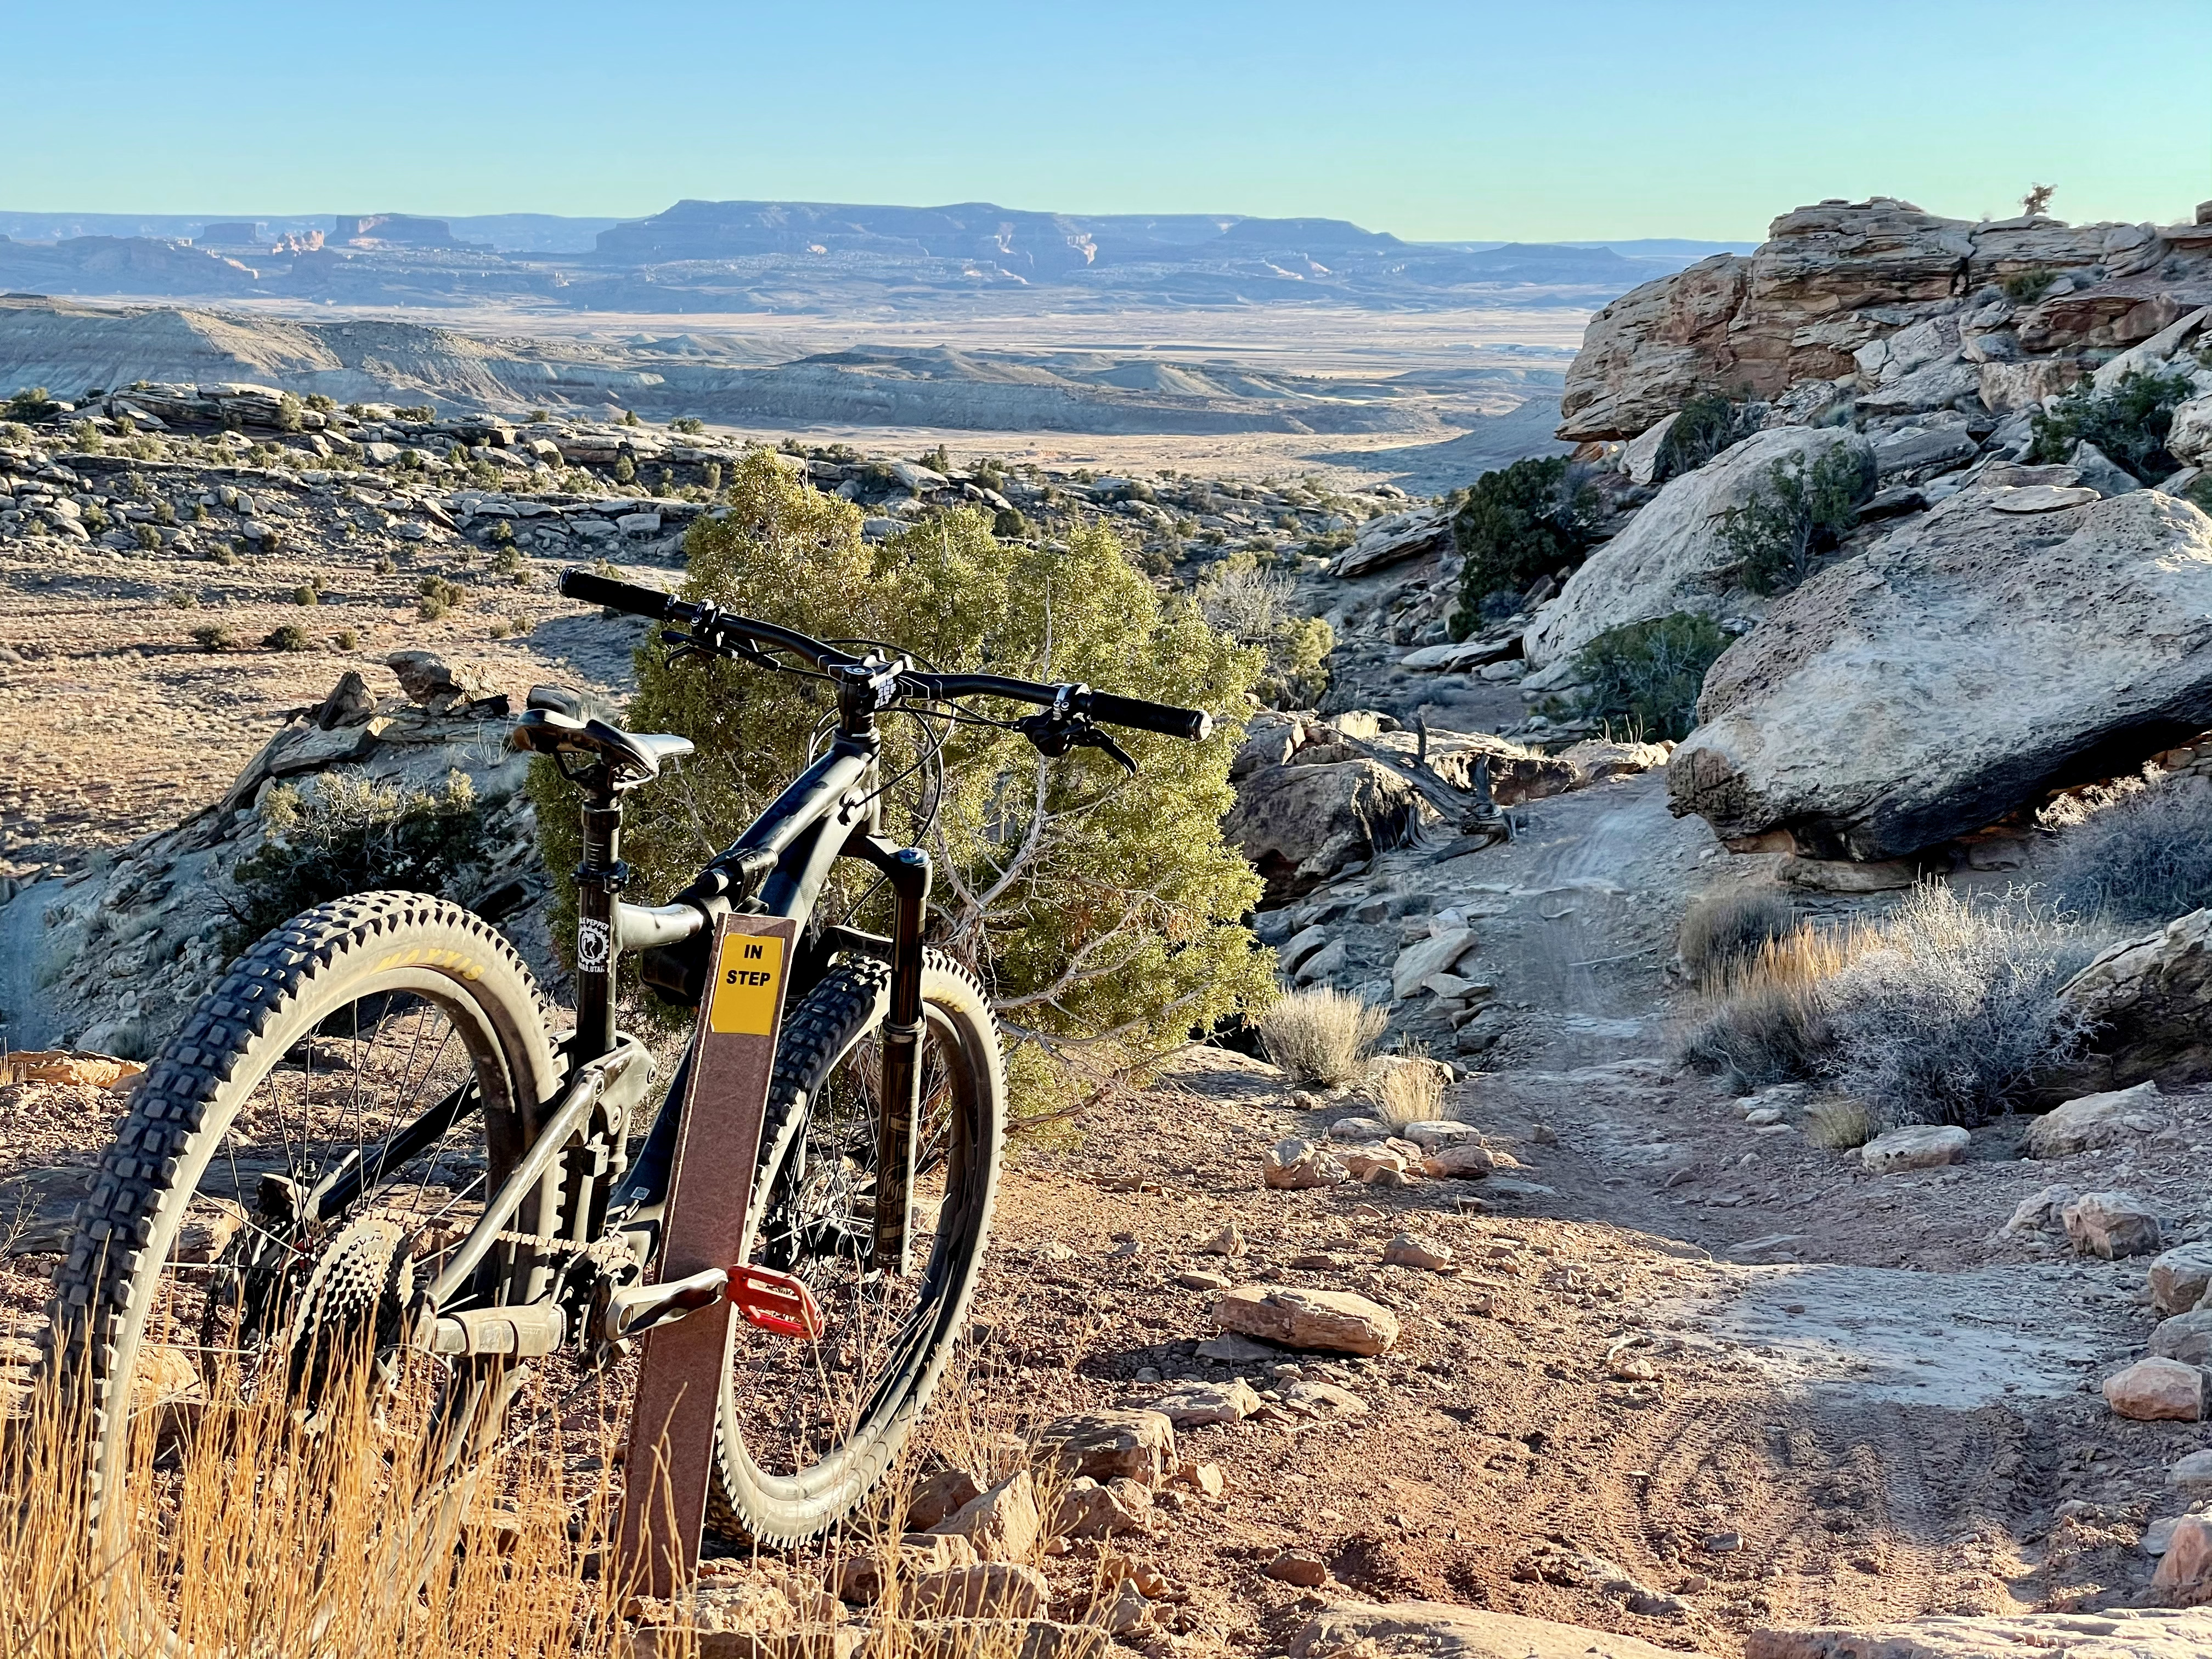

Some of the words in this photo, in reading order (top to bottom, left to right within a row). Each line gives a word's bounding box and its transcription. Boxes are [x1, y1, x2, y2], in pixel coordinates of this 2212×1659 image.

[586, 918, 610, 931] PEPPER
[744, 944, 763, 959] IN
[726, 970, 771, 986] STEP
